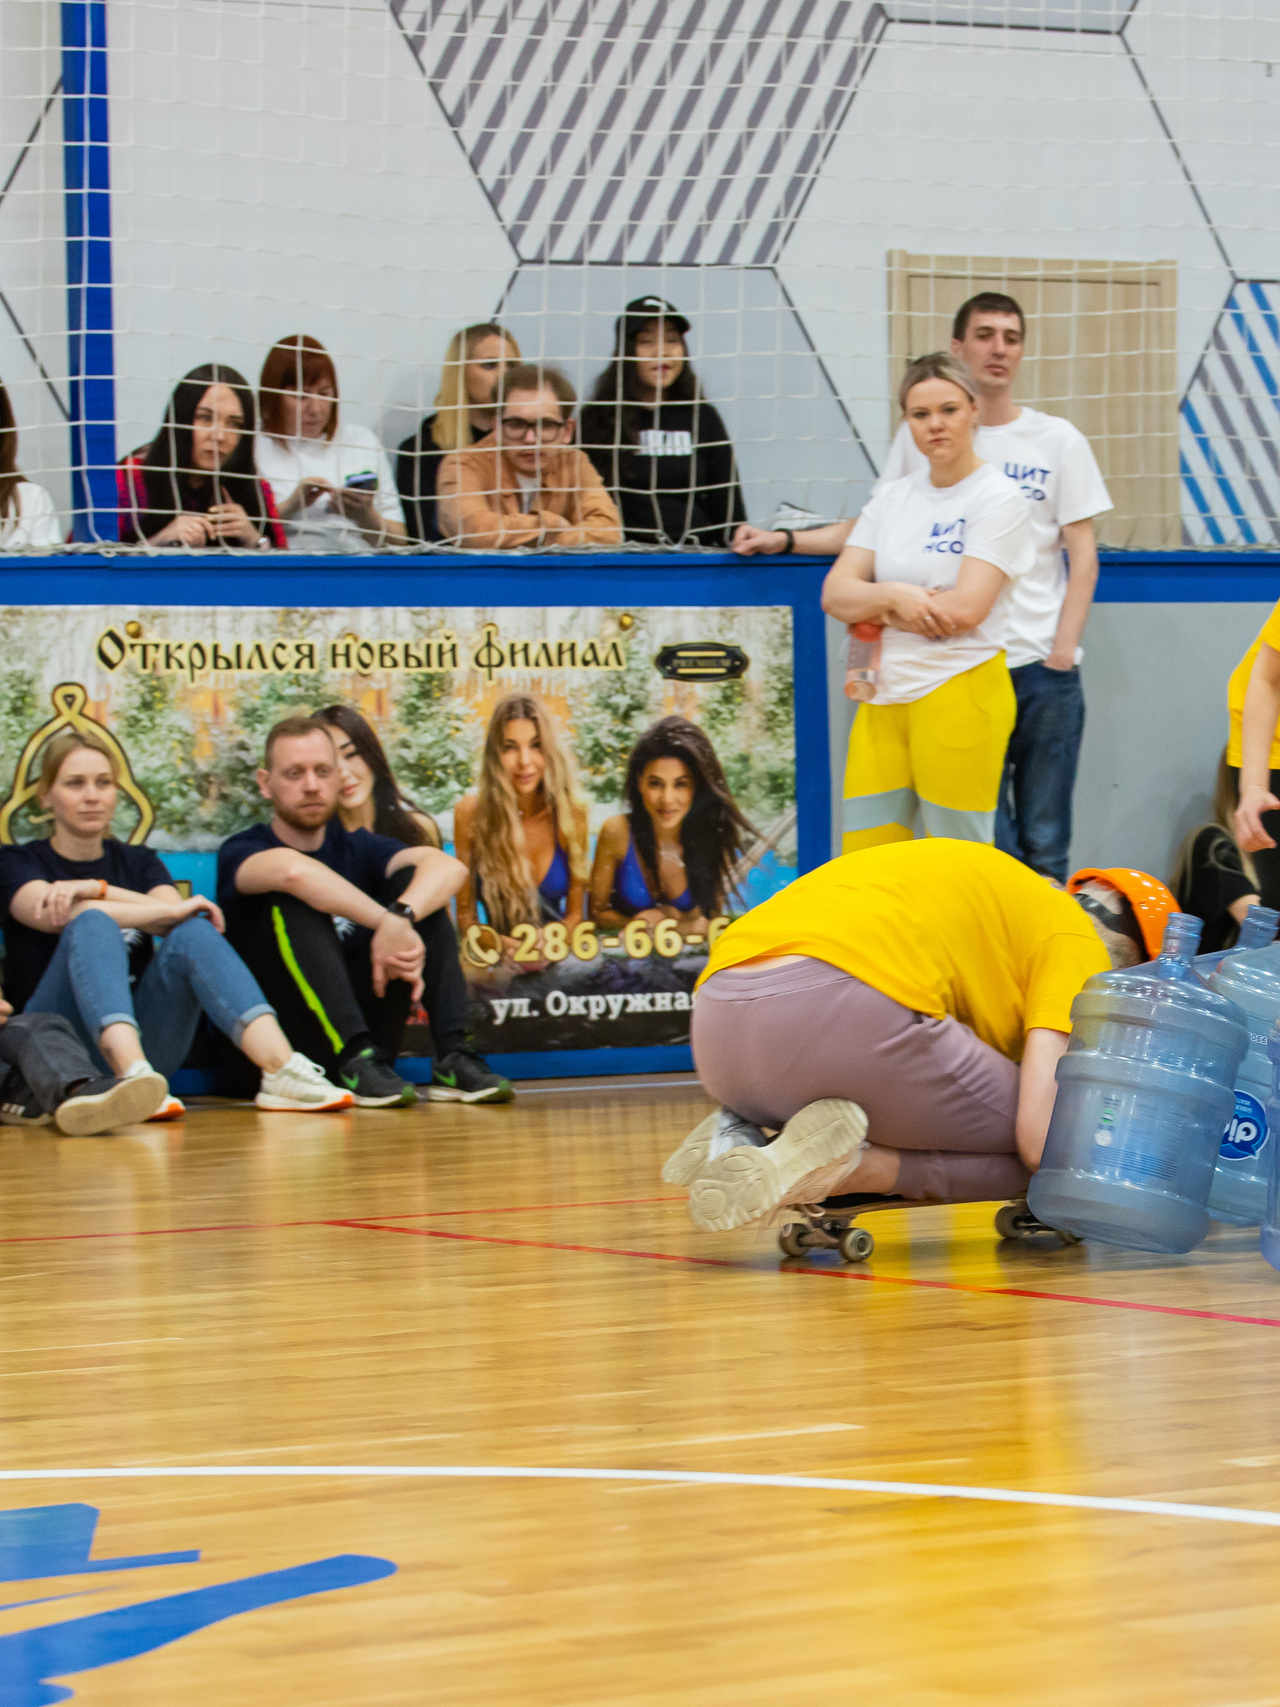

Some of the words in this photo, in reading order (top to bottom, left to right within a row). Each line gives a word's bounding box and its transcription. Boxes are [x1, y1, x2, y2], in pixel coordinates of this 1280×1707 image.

[1004, 462, 1051, 485] ЦИТ
[97, 628, 316, 683] Открылся
[331, 634, 460, 676] новый
[473, 628, 626, 681] филиал
[490, 997, 540, 1025] ул.
[545, 990, 698, 1020] Окружна
[1222, 1117, 1258, 1144] di
